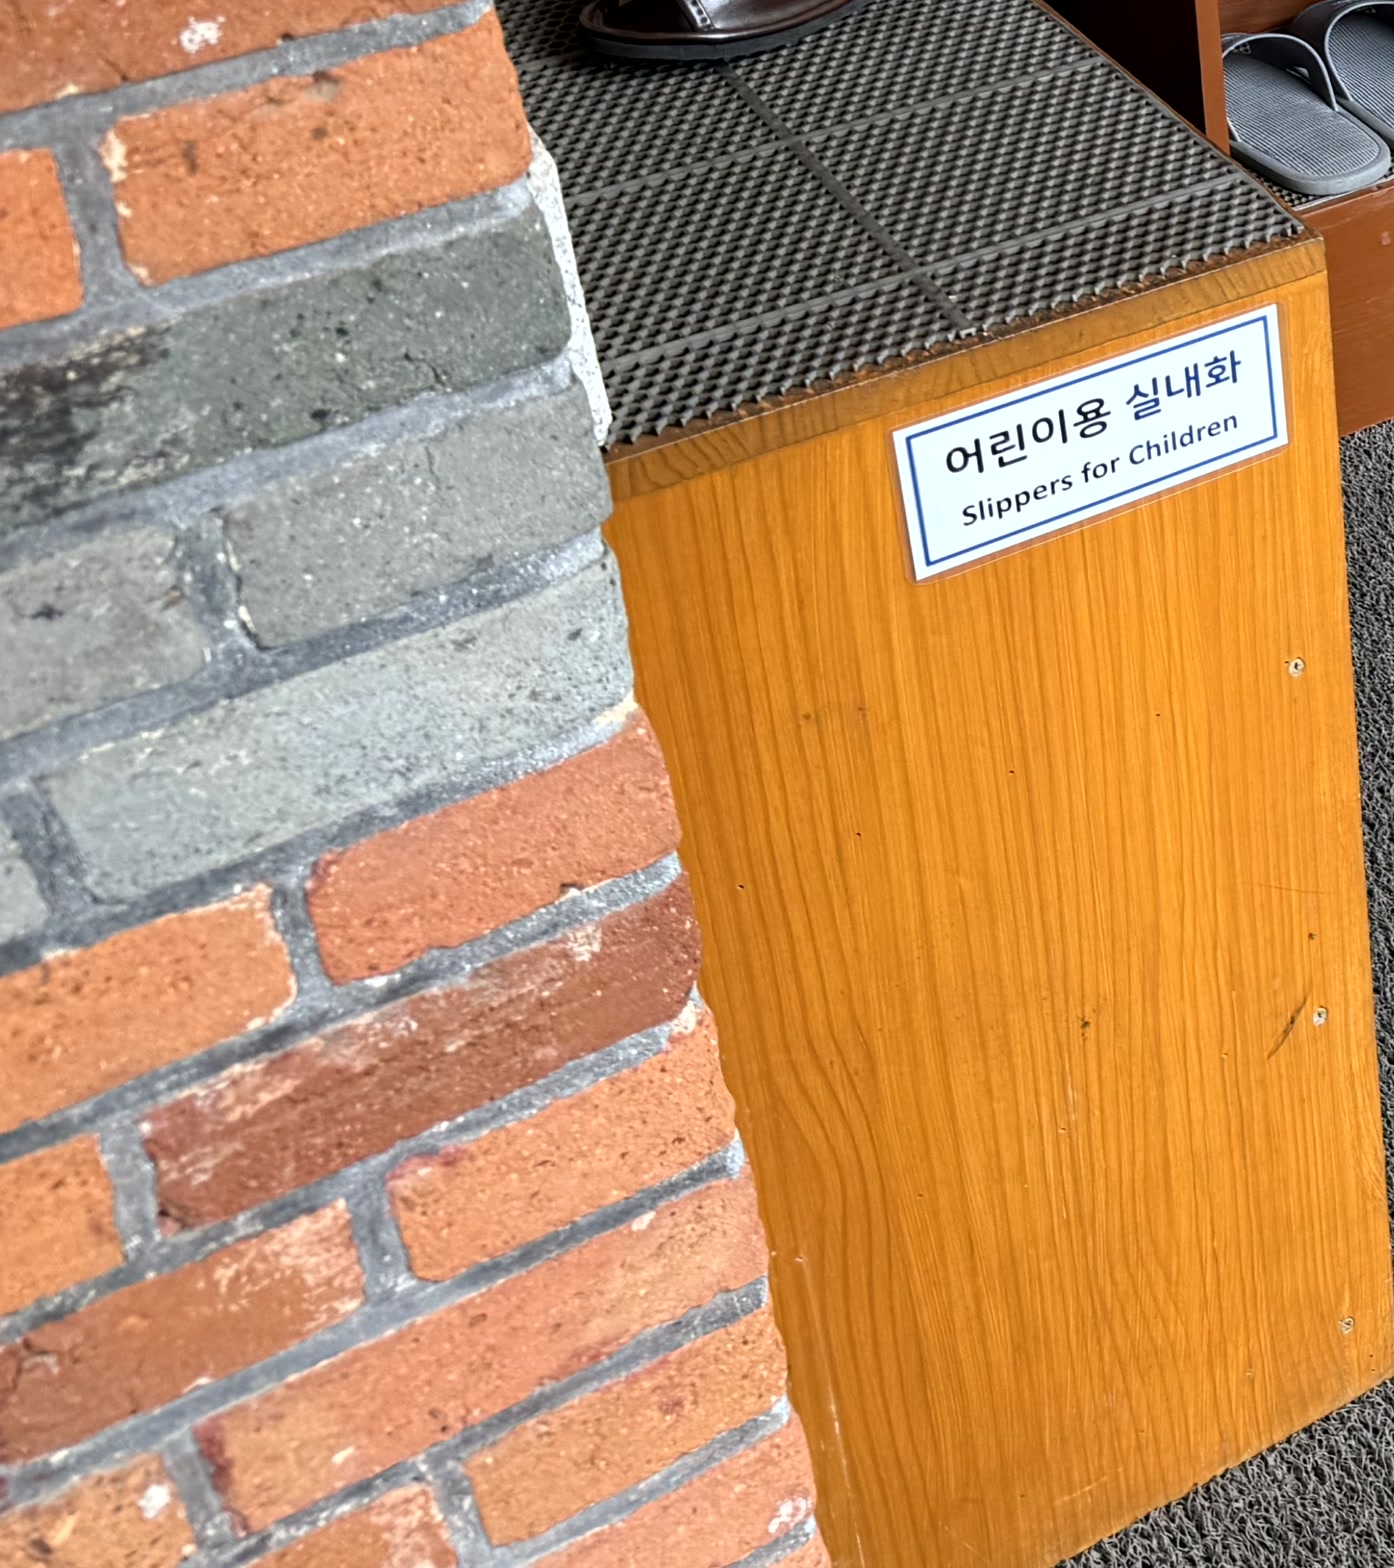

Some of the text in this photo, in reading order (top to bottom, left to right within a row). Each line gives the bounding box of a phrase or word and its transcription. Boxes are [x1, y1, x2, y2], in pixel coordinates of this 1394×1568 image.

[946, 350, 1242, 473] 어린이용 실내화
[962, 415, 1239, 526] Slippers for Children
